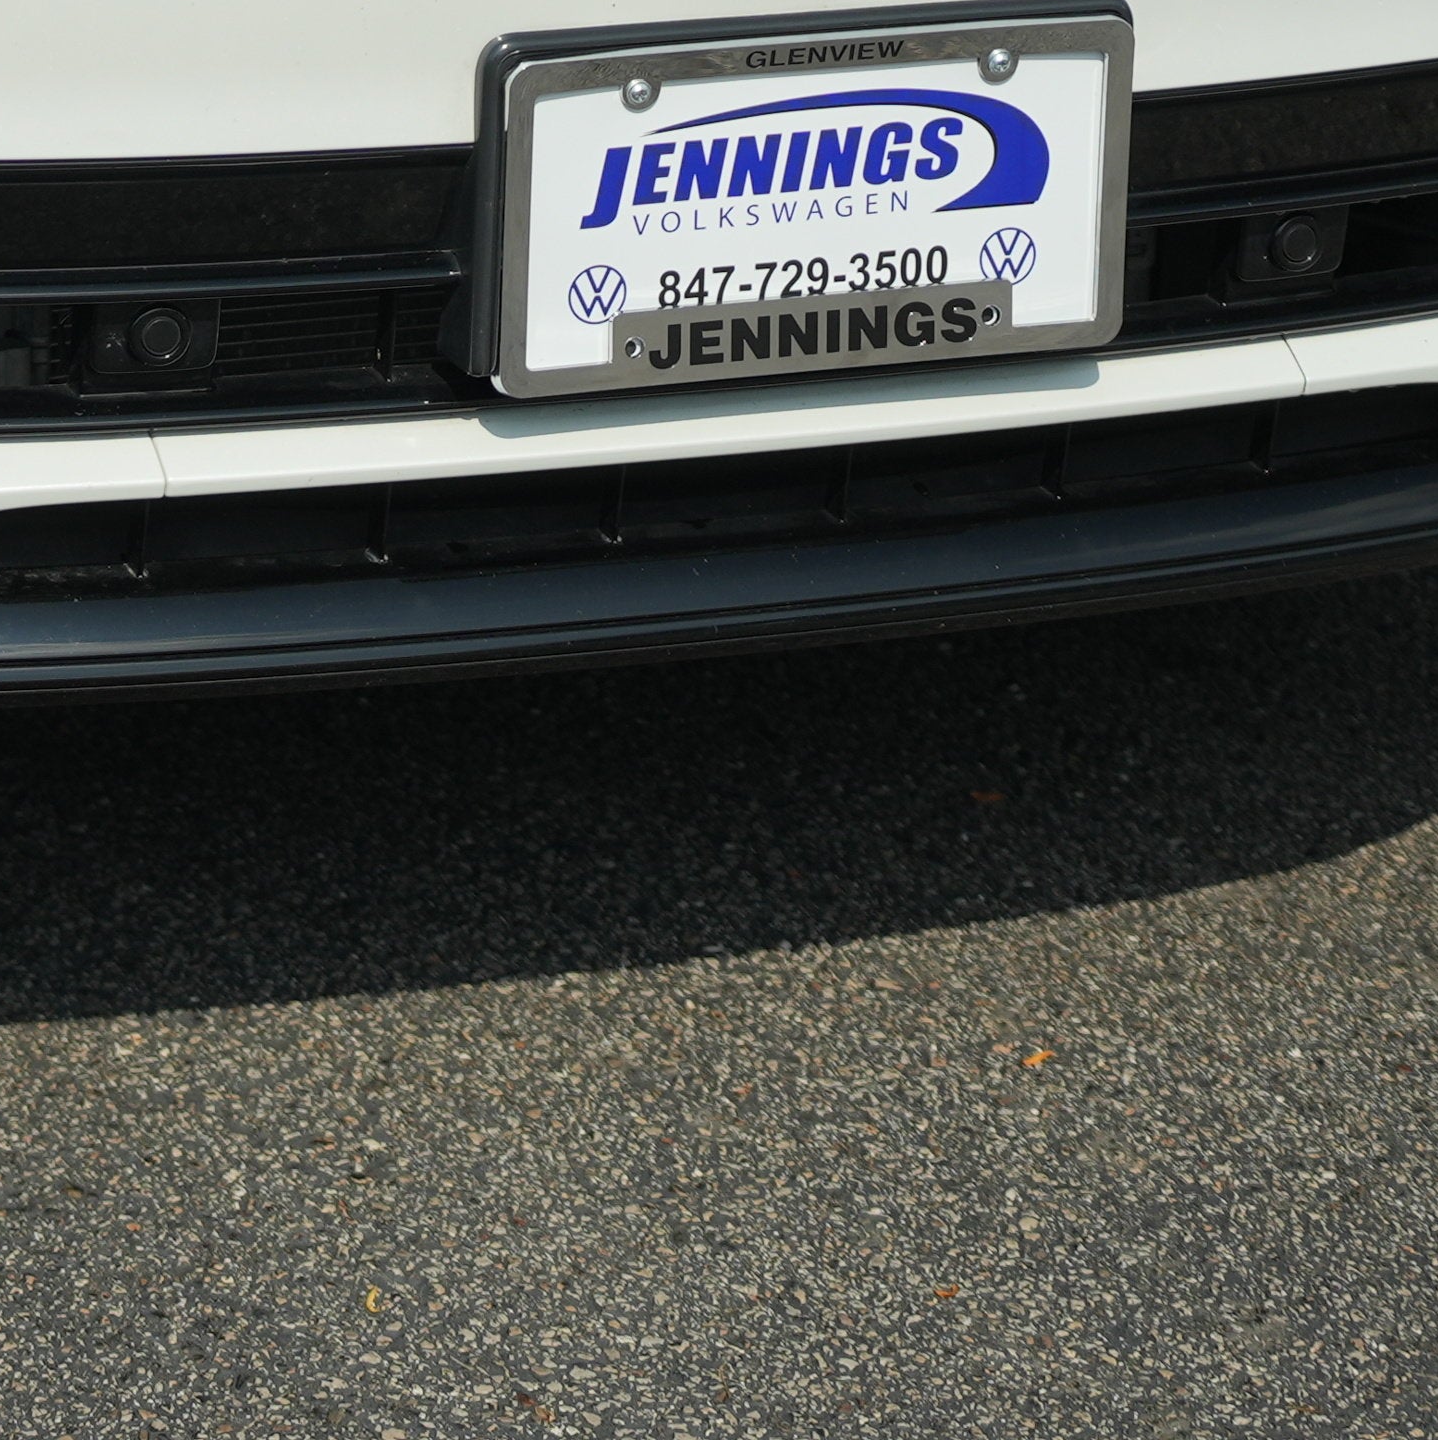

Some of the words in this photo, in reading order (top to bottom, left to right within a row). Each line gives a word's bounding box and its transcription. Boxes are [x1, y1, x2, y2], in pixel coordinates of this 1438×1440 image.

[744, 39, 906, 70] GLENVIEW
[579, 116, 964, 231] JENNINGS
[633, 189, 910, 236] VOLKSWAGEN
[658, 244, 949, 311] 847-729-3500
[649, 296, 979, 370] JENNINGS
